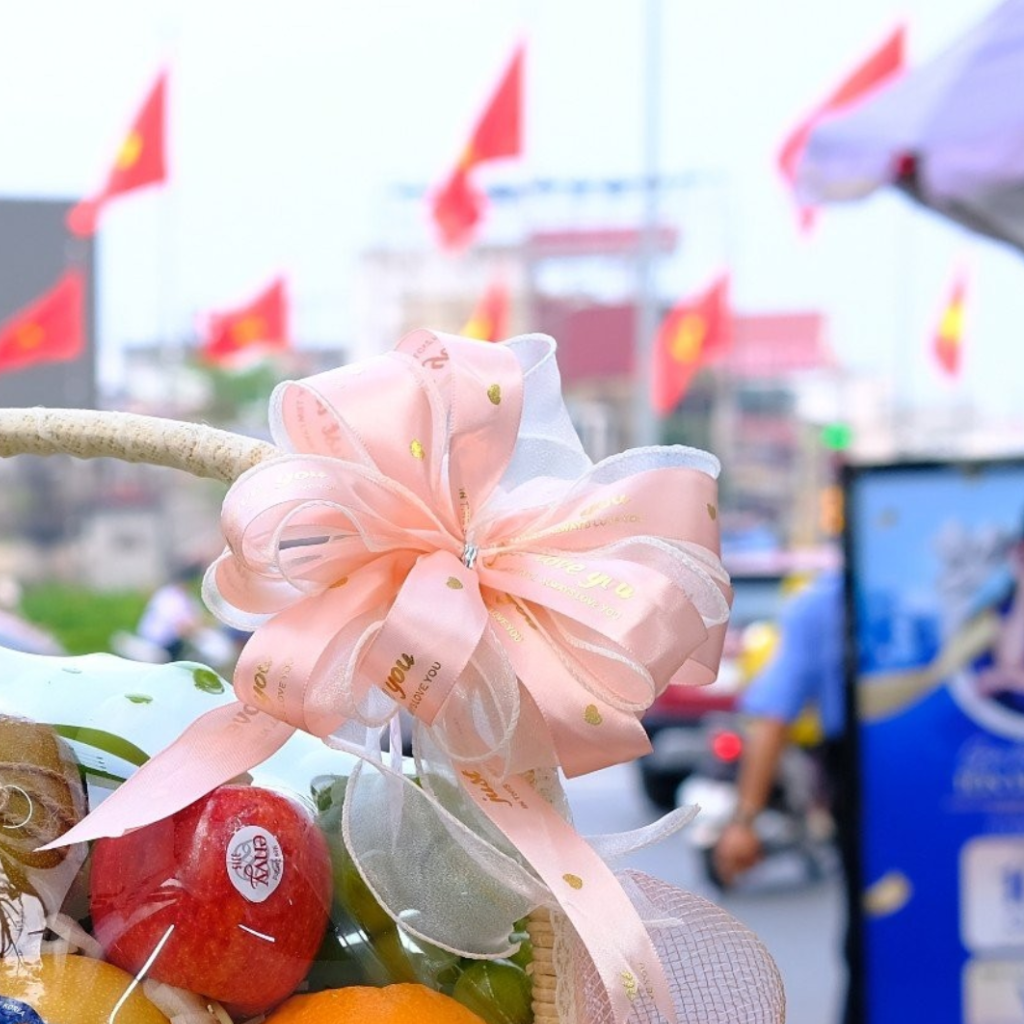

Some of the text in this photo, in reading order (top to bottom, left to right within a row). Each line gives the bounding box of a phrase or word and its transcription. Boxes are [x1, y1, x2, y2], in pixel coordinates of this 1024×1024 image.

[505, 624, 524, 643] YOU
[385, 653, 415, 700] you
[414, 661, 442, 707] LOVE YOU
[244, 835, 269, 890] envy
[2, 1003, 26, 1017] KOREA
